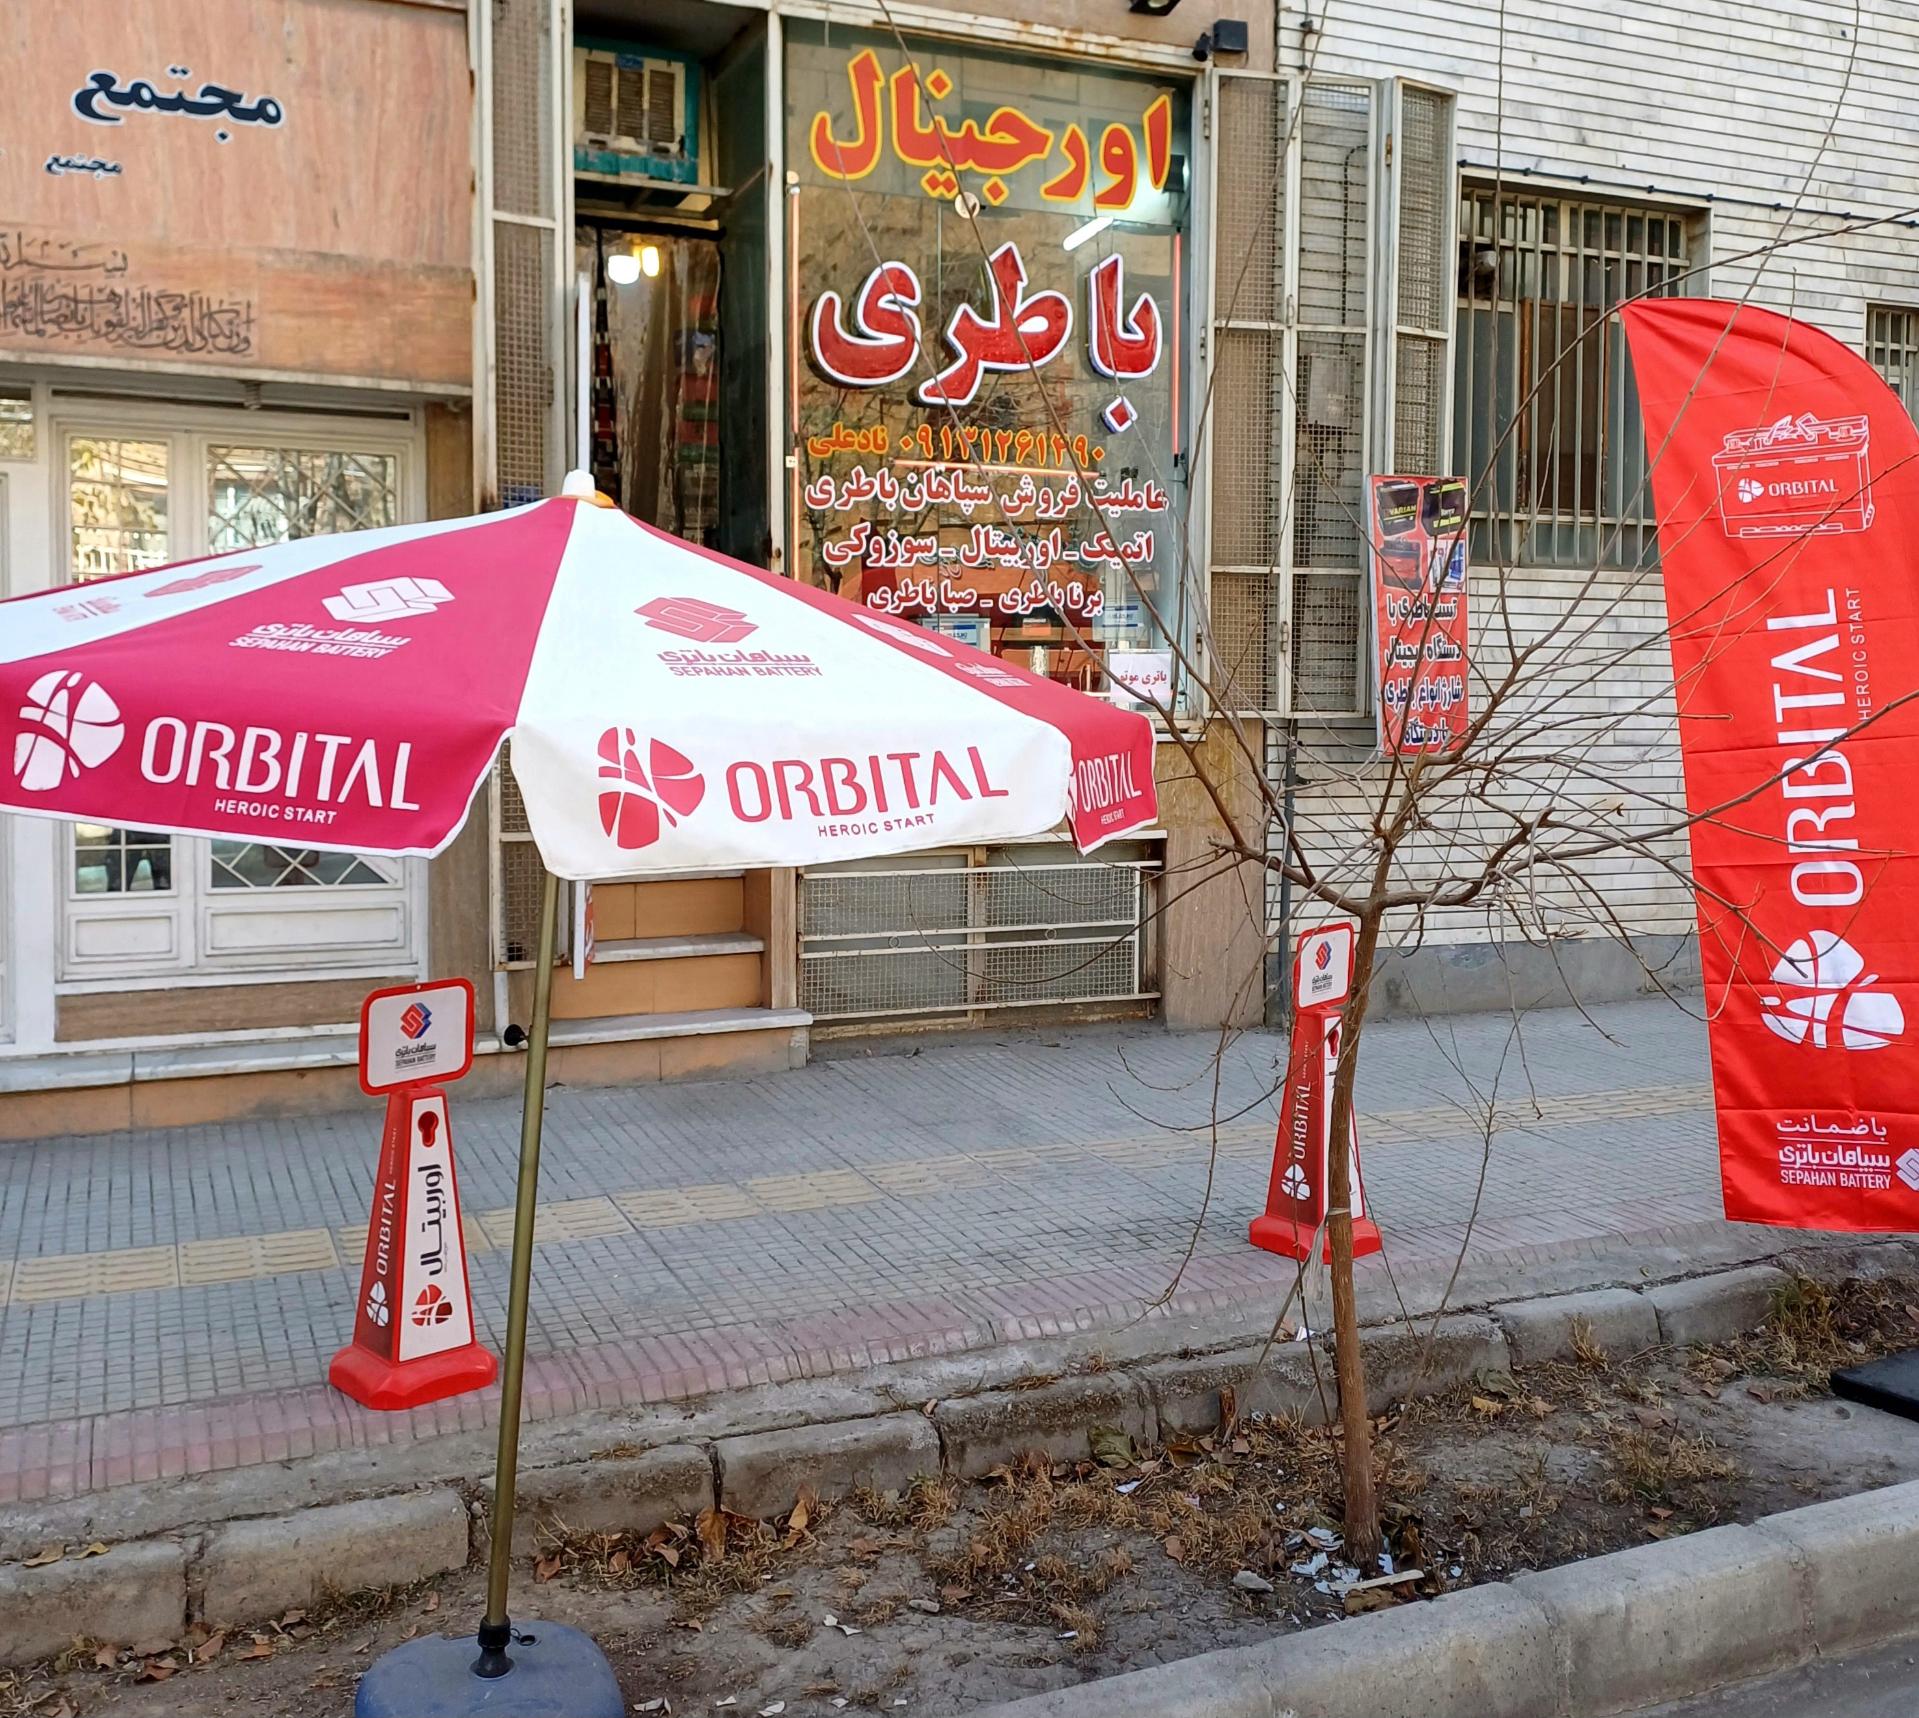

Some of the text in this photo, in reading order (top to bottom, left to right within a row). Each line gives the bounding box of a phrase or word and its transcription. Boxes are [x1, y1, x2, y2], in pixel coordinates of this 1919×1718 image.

[73, 64, 285, 144] مجتمع
[810, 48, 1172, 210] اورجینال
[46, 152, 123, 180] مجتمع
[812, 241, 1163, 435] باطری
[804, 466, 1169, 517] عاملیت فروش سپاهان باطری
[1768, 479, 1839, 497] ORBITAL
[822, 522, 936, 568] سوزوکی
[961, 524, 1061, 568] اوربیتال
[1079, 528, 1153, 567] اتمیک
[866, 577, 937, 614] باطری
[939, 579, 977, 614] صبا
[228, 636, 394, 659] SEPAHAN BATTERY
[1845, 587, 1871, 722] HEROIC START
[669, 666, 823, 677] SEPAHAN BATTERY
[139, 716, 421, 812] ORBITAL
[1767, 587, 1864, 907] ORBITAL
[725, 745, 1009, 823] ORBITAL
[1078, 750, 1142, 813] ORBITAL
[213, 797, 337, 826] HEROIC START
[817, 812, 936, 839] HEROIC START
[1778, 1143, 1891, 1172] سپاهان باتری
[1780, 1169, 1891, 1190] SEPAHAN BATTERY
[376, 1180, 396, 1276] ORBITAL
